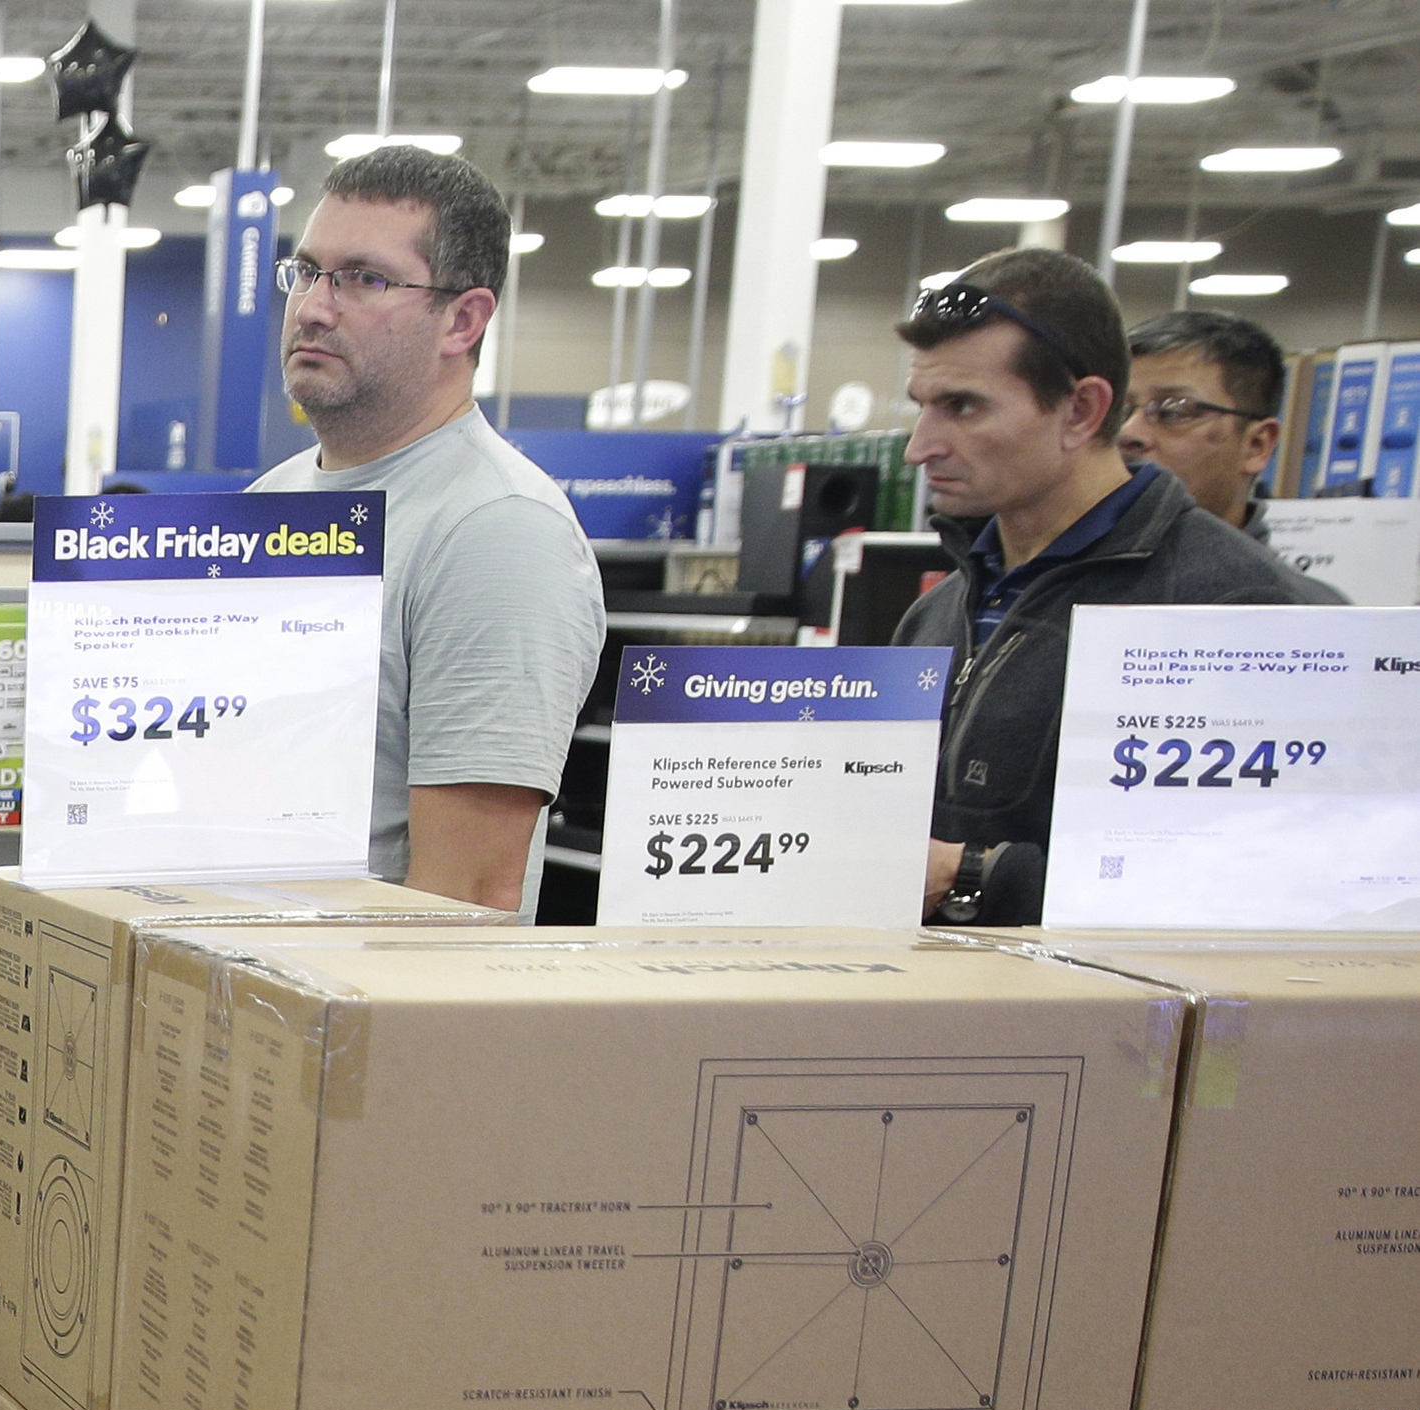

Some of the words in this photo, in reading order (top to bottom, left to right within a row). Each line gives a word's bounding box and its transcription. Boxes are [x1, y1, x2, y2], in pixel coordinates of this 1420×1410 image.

[237, 226, 260, 316] CAMERAS
[55, 526, 150, 560] Black
[155, 525, 260, 564] Friday
[264, 524, 365, 556] deals.
[133, 615, 208, 626] Reference
[213, 614, 260, 626] 2-Way
[74, 627, 140, 639] Powered
[145, 626, 220, 638] Bookshelf
[281, 619, 345, 635] Klipsch
[74, 640, 135, 651] Speaker
[1124, 649, 1188, 660] Klipsch
[1194, 649, 1285, 660] Reference
[1290, 649, 1345, 660] Series
[1123, 662, 1163, 672] Dual
[1168, 662, 1234, 673] Passive
[1240, 662, 1297, 675] 2-Way
[1302, 662, 1350, 672] Floor
[73, 677, 109, 690] SAVE
[112, 676, 139, 689] $75
[1121, 675, 1194, 687] Speaker
[684, 674, 765, 703] Giving
[770, 676, 827, 703] gets
[831, 674, 879, 699] fun.
[1116, 715, 1160, 728] SAVE
[1164, 714, 1207, 729] $225
[652, 757, 704, 775] Klipsch
[707, 757, 779, 770] Reference
[781, 756, 823, 770] Series
[844, 760, 905, 776] Klipsch
[651, 777, 713, 790] Powered
[717, 776, 794, 789] Subwoofer
[648, 814, 682, 826] SAVE
[685, 813, 719, 826] $225
[600, 1201, 632, 1212] HORN
[1335, 1229, 1392, 1241] ALUMINUM
[481, 1246, 540, 1258] ALUMINUM
[543, 1245, 583, 1257] LINEAR
[587, 1244, 626, 1256] TRAVEL
[505, 1259, 573, 1271] SUSPENSION
[577, 1258, 625, 1270] TWEETER
[1307, 1368, 1413, 1381] SCRATCH-RESISTANT
[462, 1387, 572, 1400] SCRATCH-RESISTANT
[576, 1387, 612, 1398] FINISH
